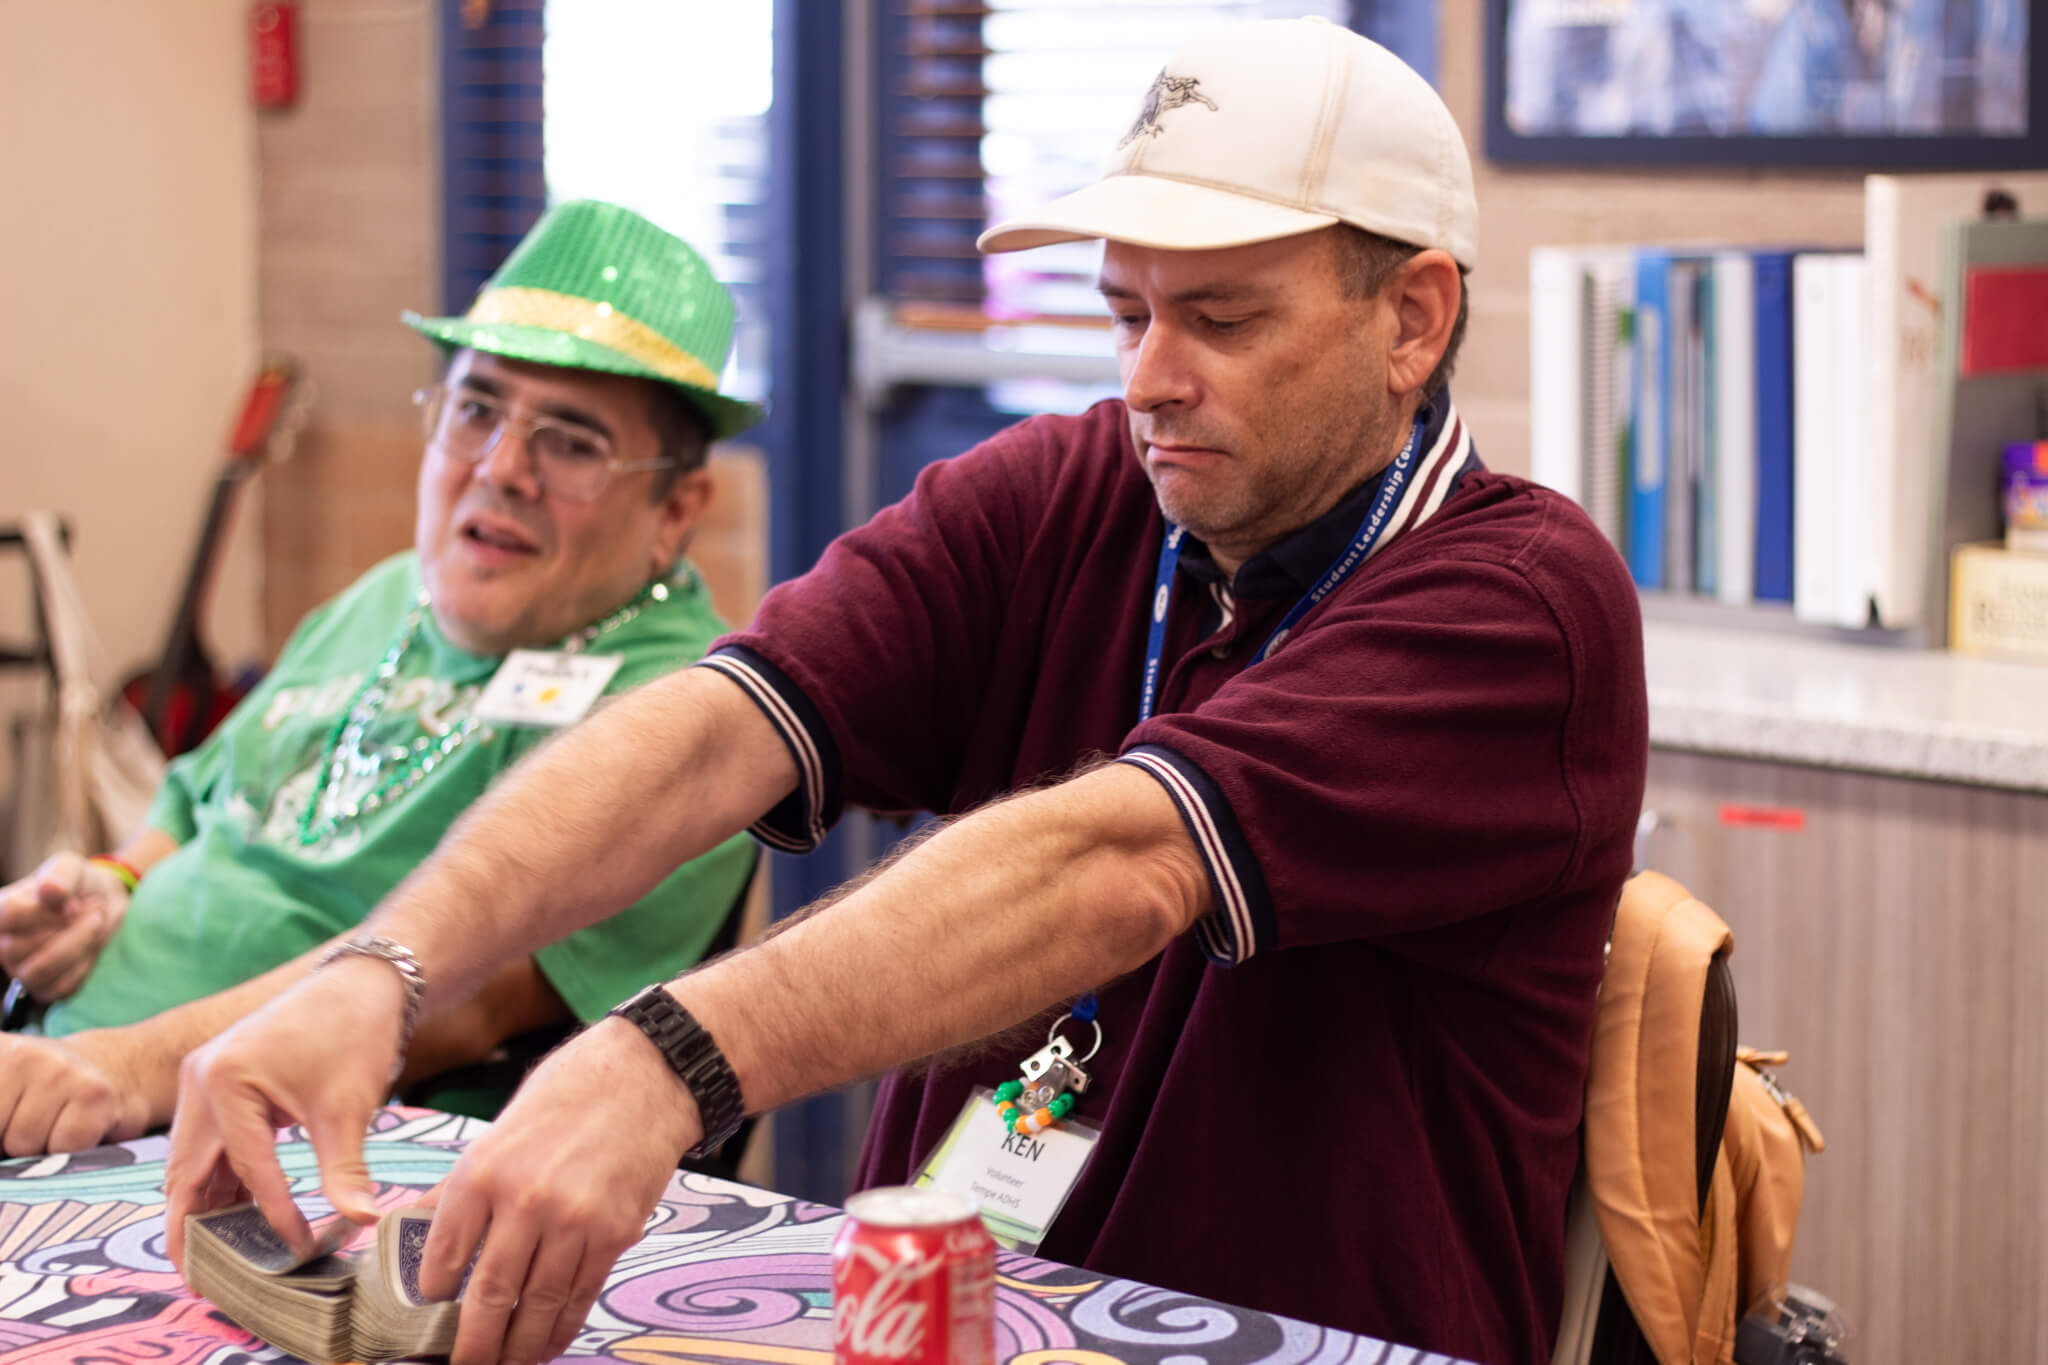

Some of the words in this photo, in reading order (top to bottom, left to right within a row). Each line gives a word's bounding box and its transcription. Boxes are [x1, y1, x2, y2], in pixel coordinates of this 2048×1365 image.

[1311, 552, 1360, 602] Student
[1355, 469, 1405, 551] Leadership
[1001, 1132, 1046, 1162] KEN
[986, 1167, 1025, 1188] Volunteer
